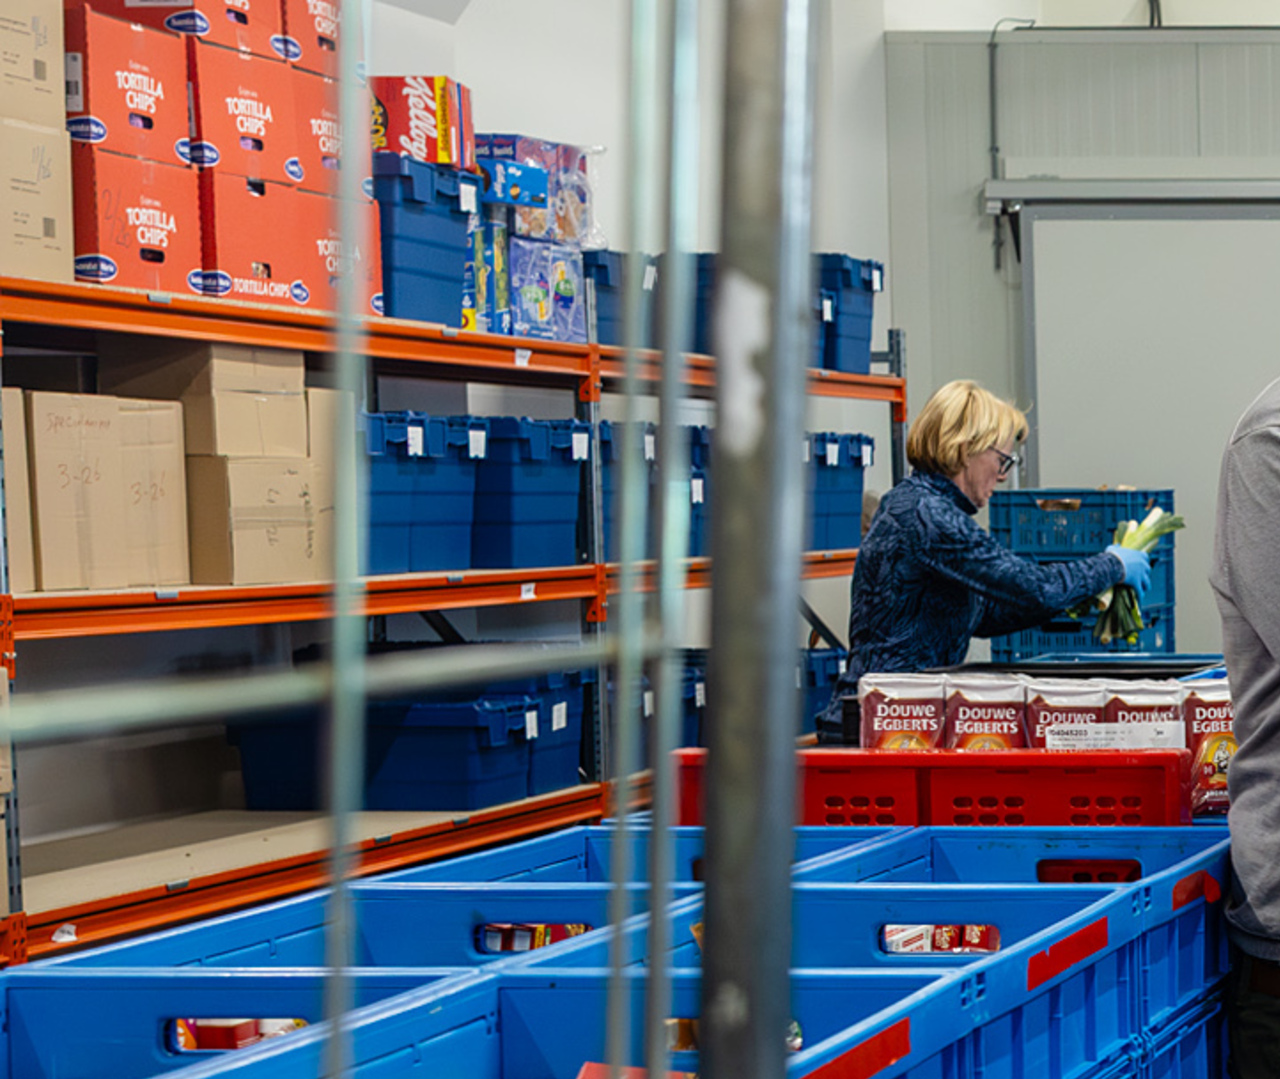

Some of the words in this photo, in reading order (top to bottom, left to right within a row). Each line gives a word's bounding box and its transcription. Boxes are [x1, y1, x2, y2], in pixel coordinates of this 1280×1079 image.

[115, 71, 164, 99] TORTILLA
[126, 92, 156, 114] CHIPS
[225, 97, 273, 123] TORTILLA
[236, 116, 265, 136] CHIPS
[399, 76, 437, 162] Kellog
[126, 207, 177, 233] TORTILLA
[137, 227, 168, 248] CHIPS
[233, 278, 268, 296] TORTILLA
[268, 282, 290, 298] CHIPS
[874, 717, 938, 731] EGBERTS
[955, 721, 1018, 734] EGBERTS
